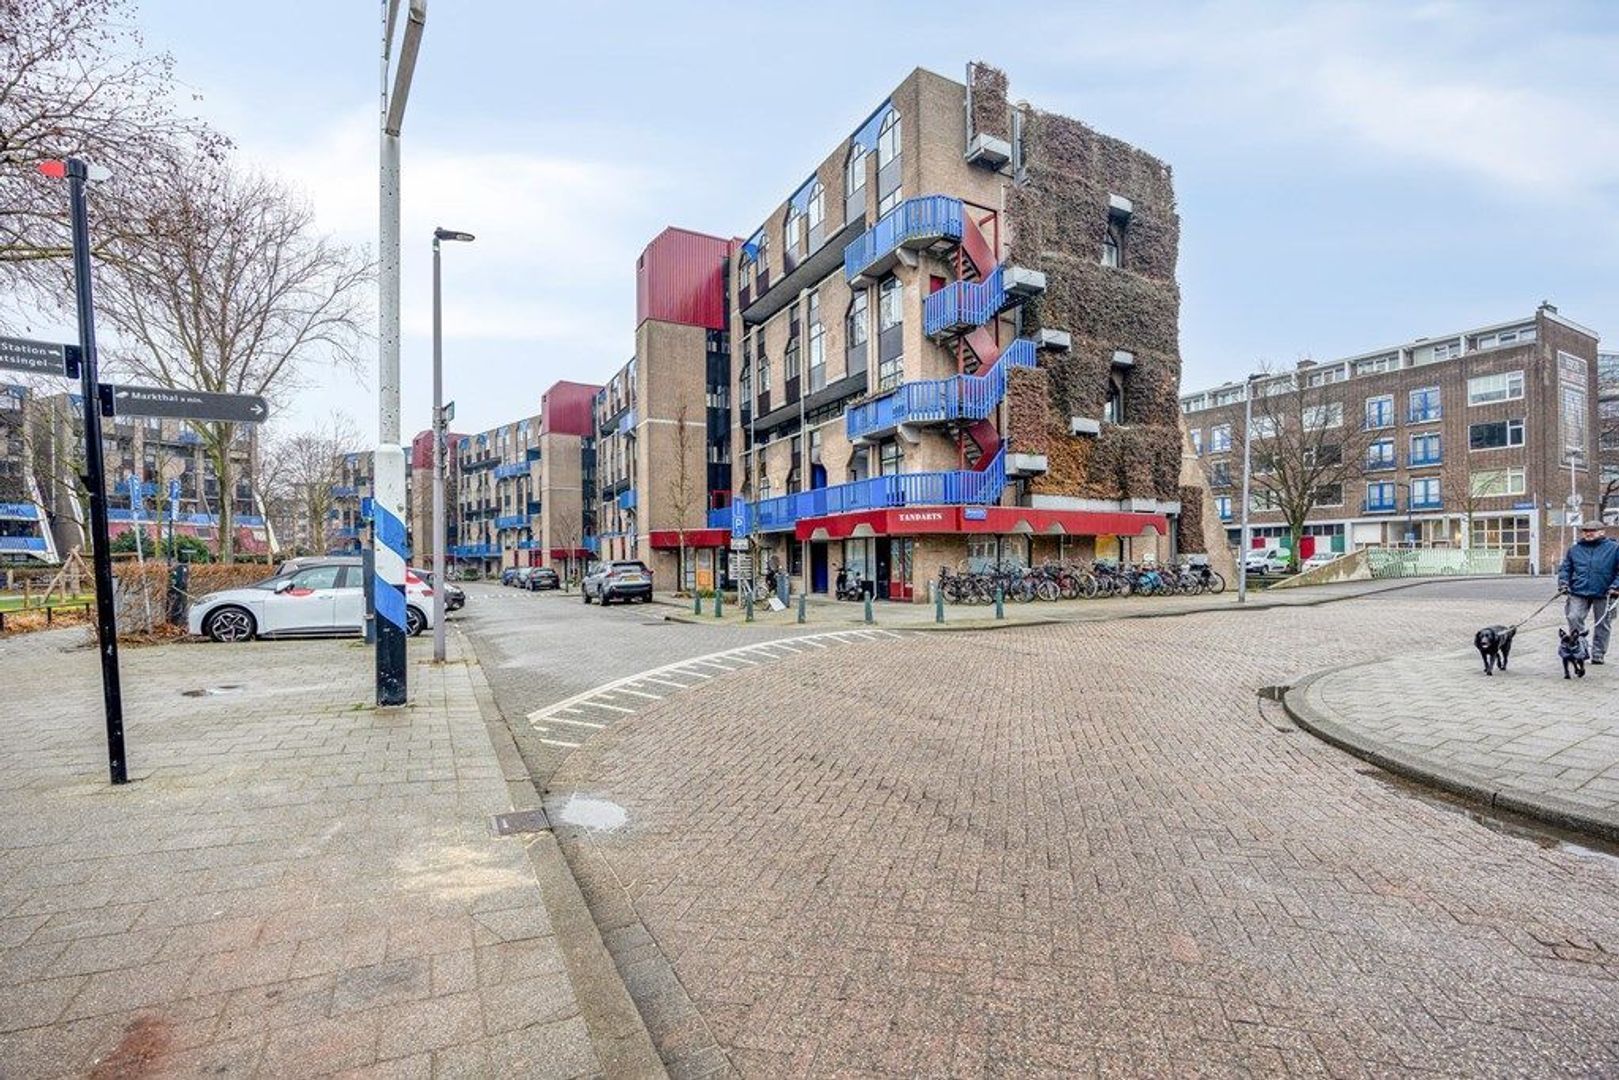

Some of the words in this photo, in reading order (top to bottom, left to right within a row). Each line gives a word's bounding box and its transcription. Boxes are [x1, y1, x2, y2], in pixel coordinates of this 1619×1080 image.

[1, 341, 47, 355] Station
[131, 391, 178, 402] Markthal
[898, 512, 943, 521] TANDARTS
